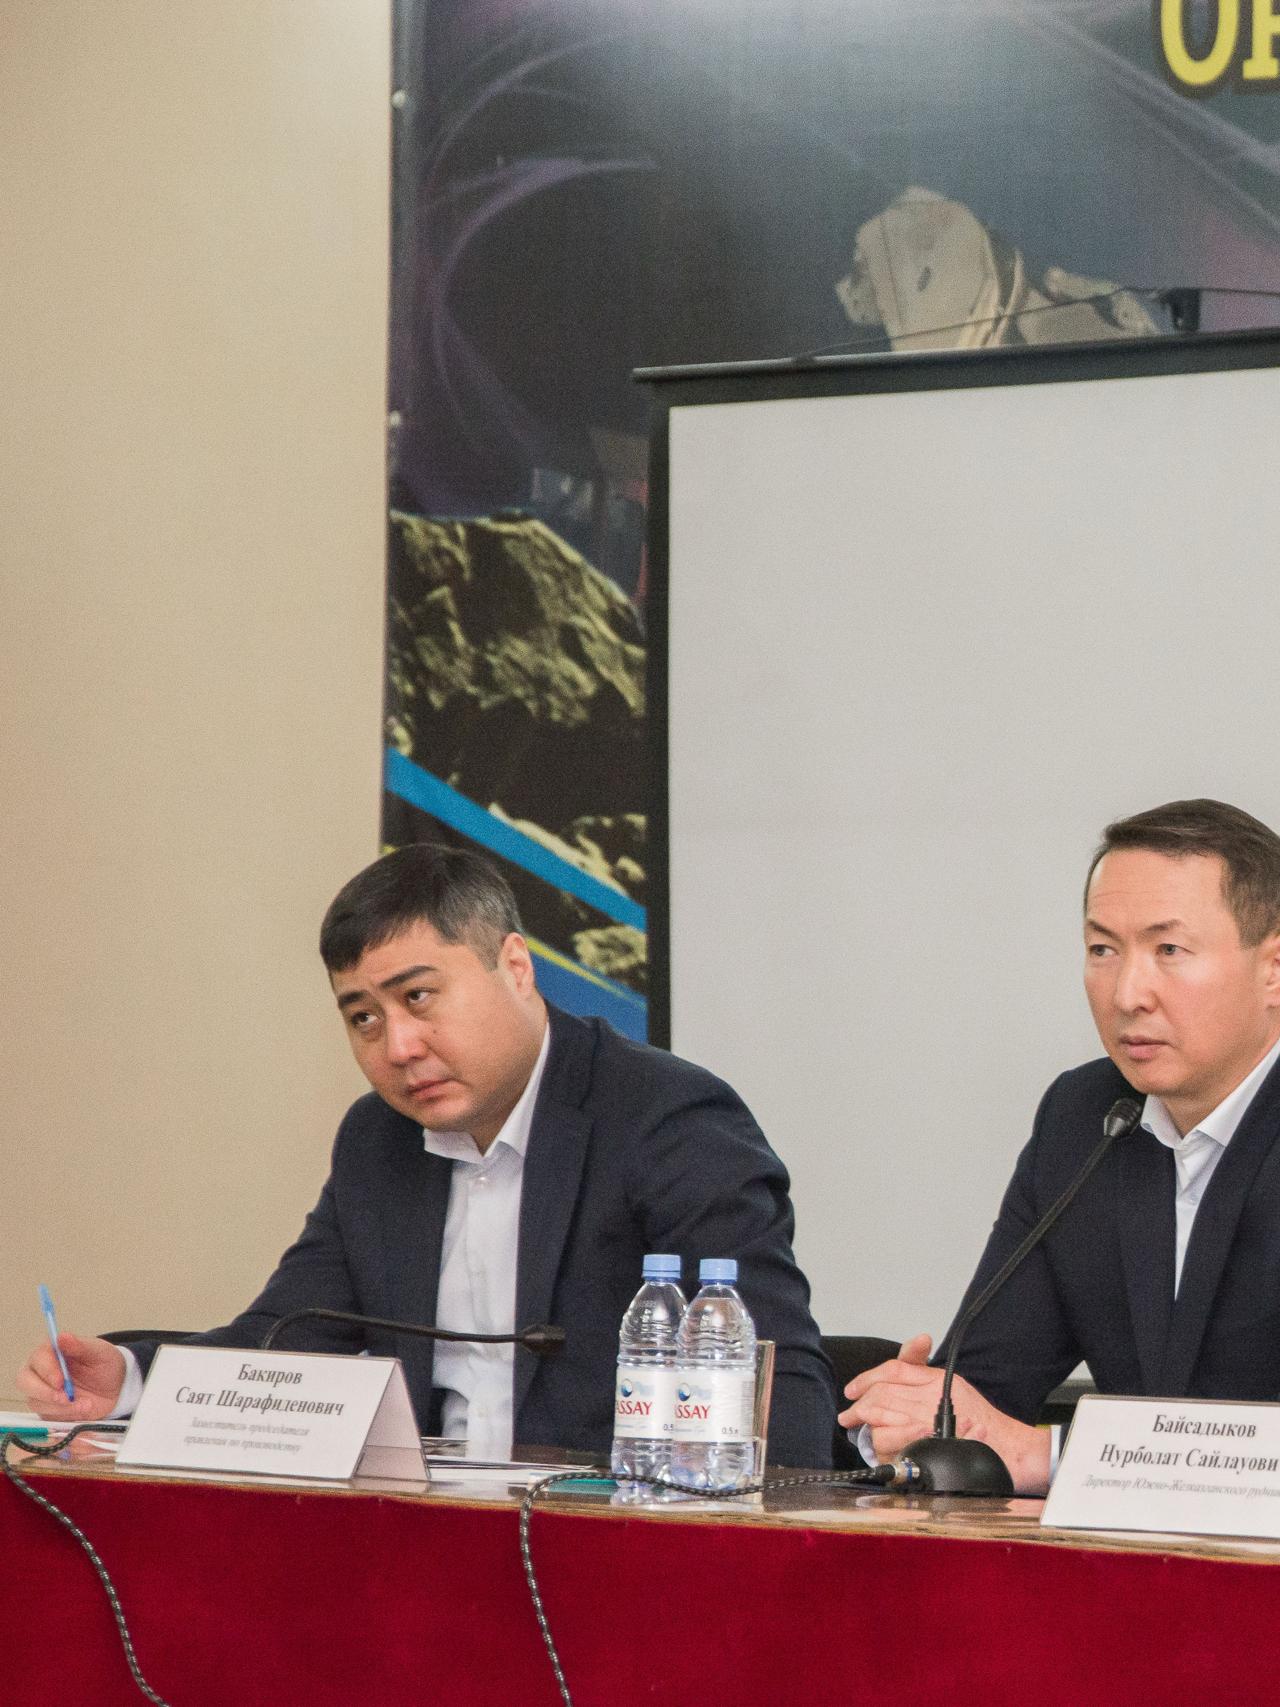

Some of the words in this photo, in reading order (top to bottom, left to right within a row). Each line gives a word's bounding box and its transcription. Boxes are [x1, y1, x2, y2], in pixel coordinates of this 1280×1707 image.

[237, 1363, 303, 1388] Бакиров
[175, 1386, 214, 1405] Саят
[1099, 1443, 1182, 1468] Нурболат
